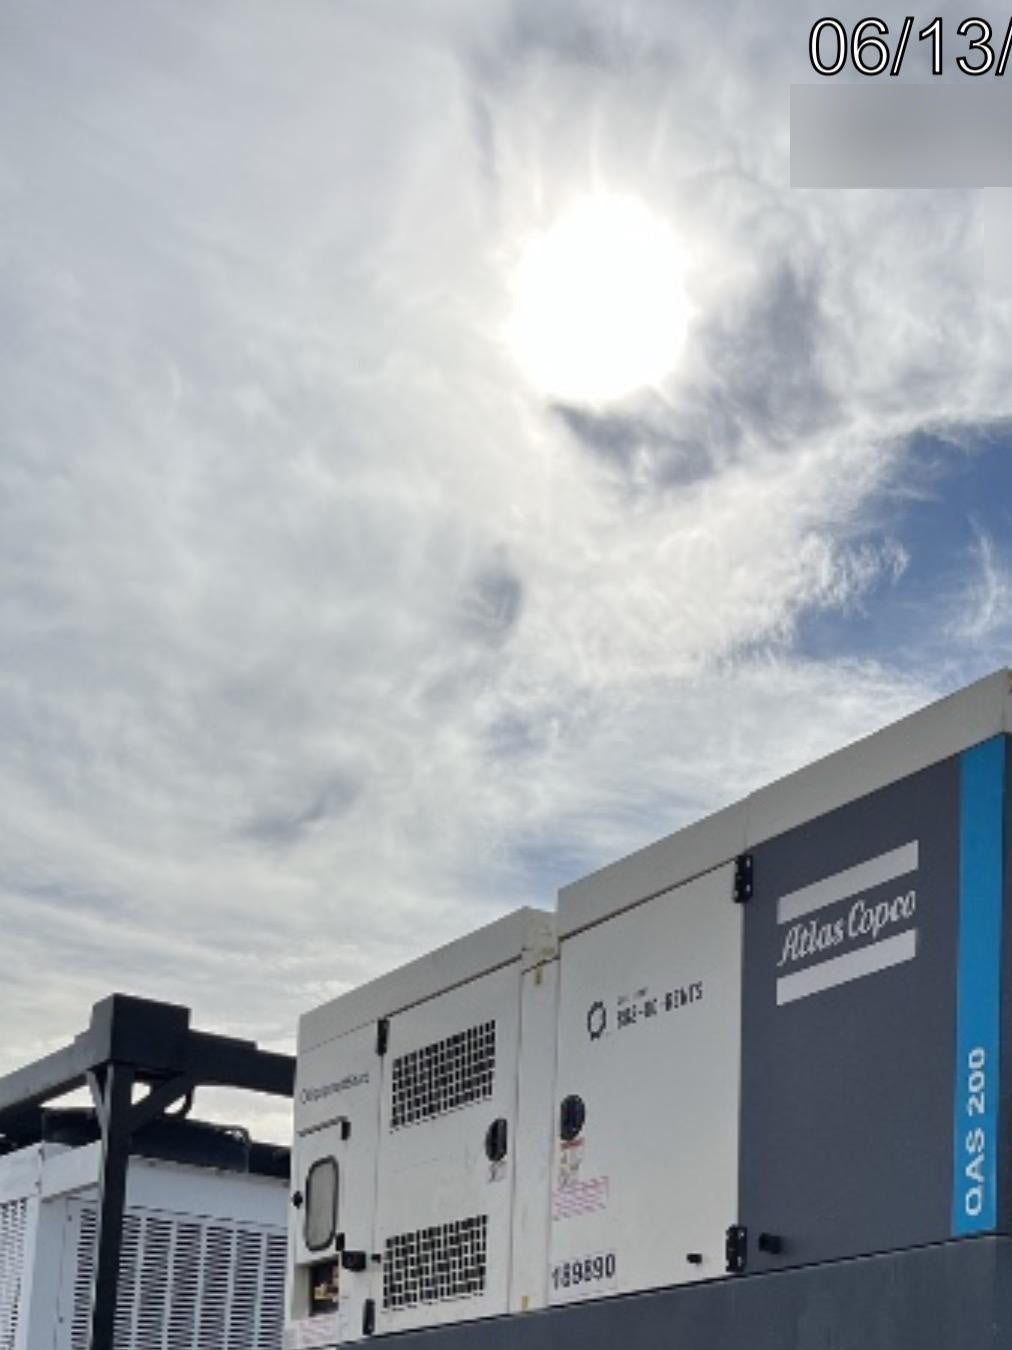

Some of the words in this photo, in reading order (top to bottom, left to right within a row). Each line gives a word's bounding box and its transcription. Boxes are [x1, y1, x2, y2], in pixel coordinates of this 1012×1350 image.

[777, 919, 844, 967] Atlas
[848, 890, 916, 939] Copco
[967, 1047, 986, 1118] 200
